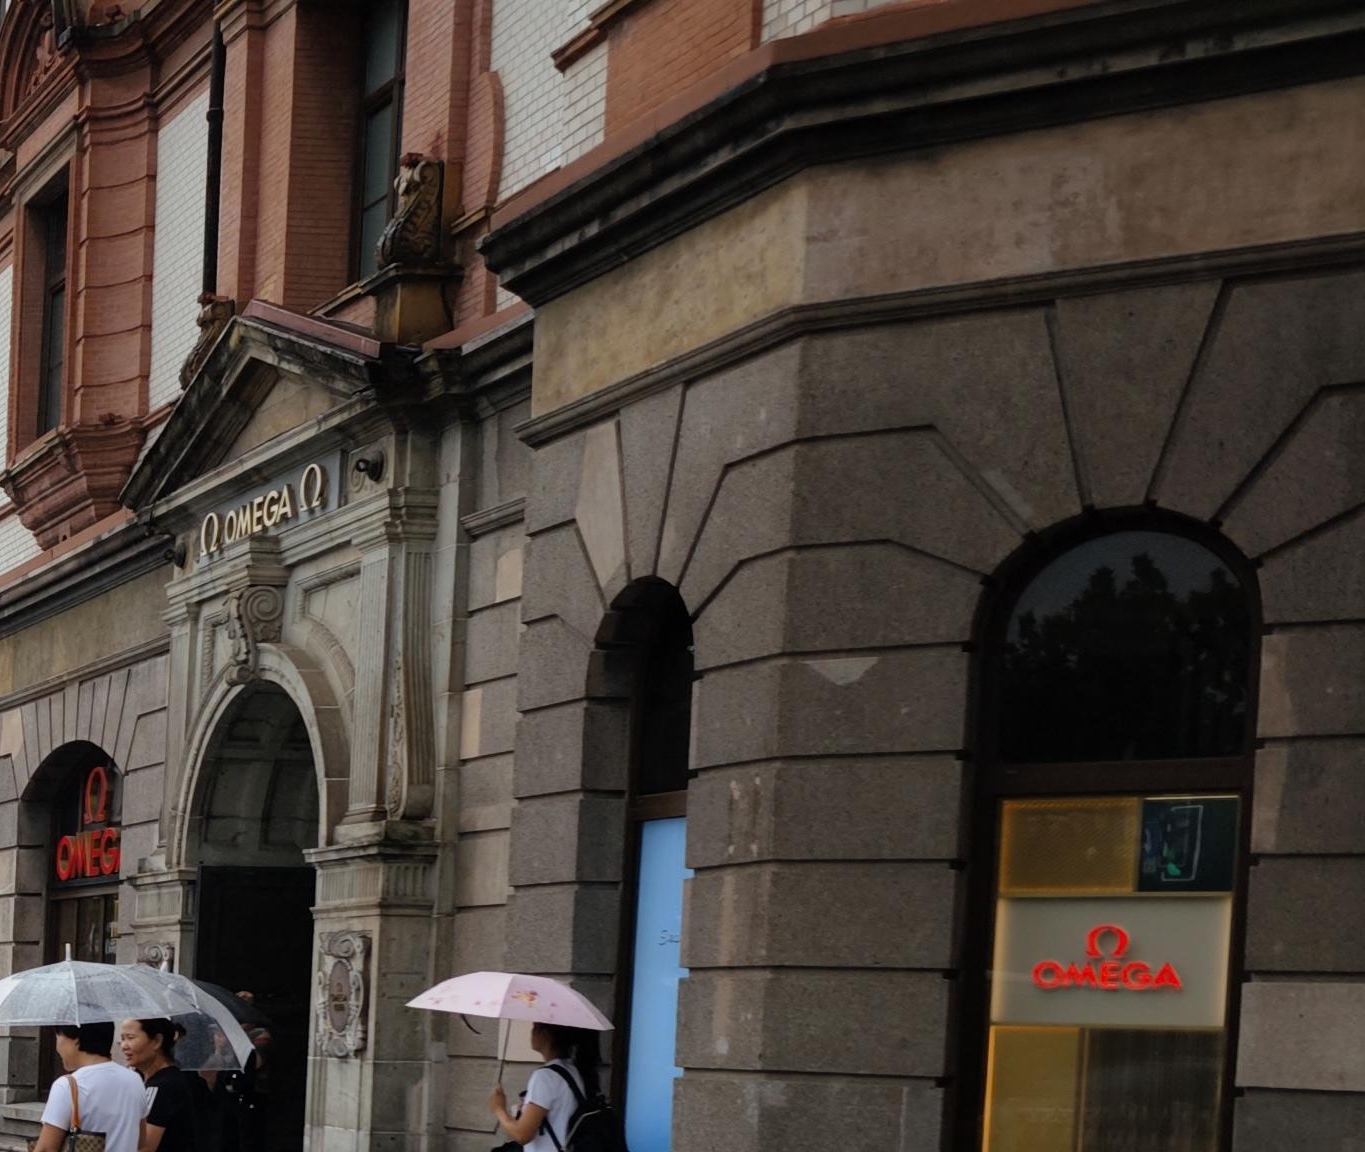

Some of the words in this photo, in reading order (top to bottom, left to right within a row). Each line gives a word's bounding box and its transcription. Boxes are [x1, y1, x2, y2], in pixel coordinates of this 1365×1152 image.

[224, 484, 292, 545] OMEGA
[56, 827, 121, 880] OMEG
[1031, 960, 1183, 990] OMEGA
